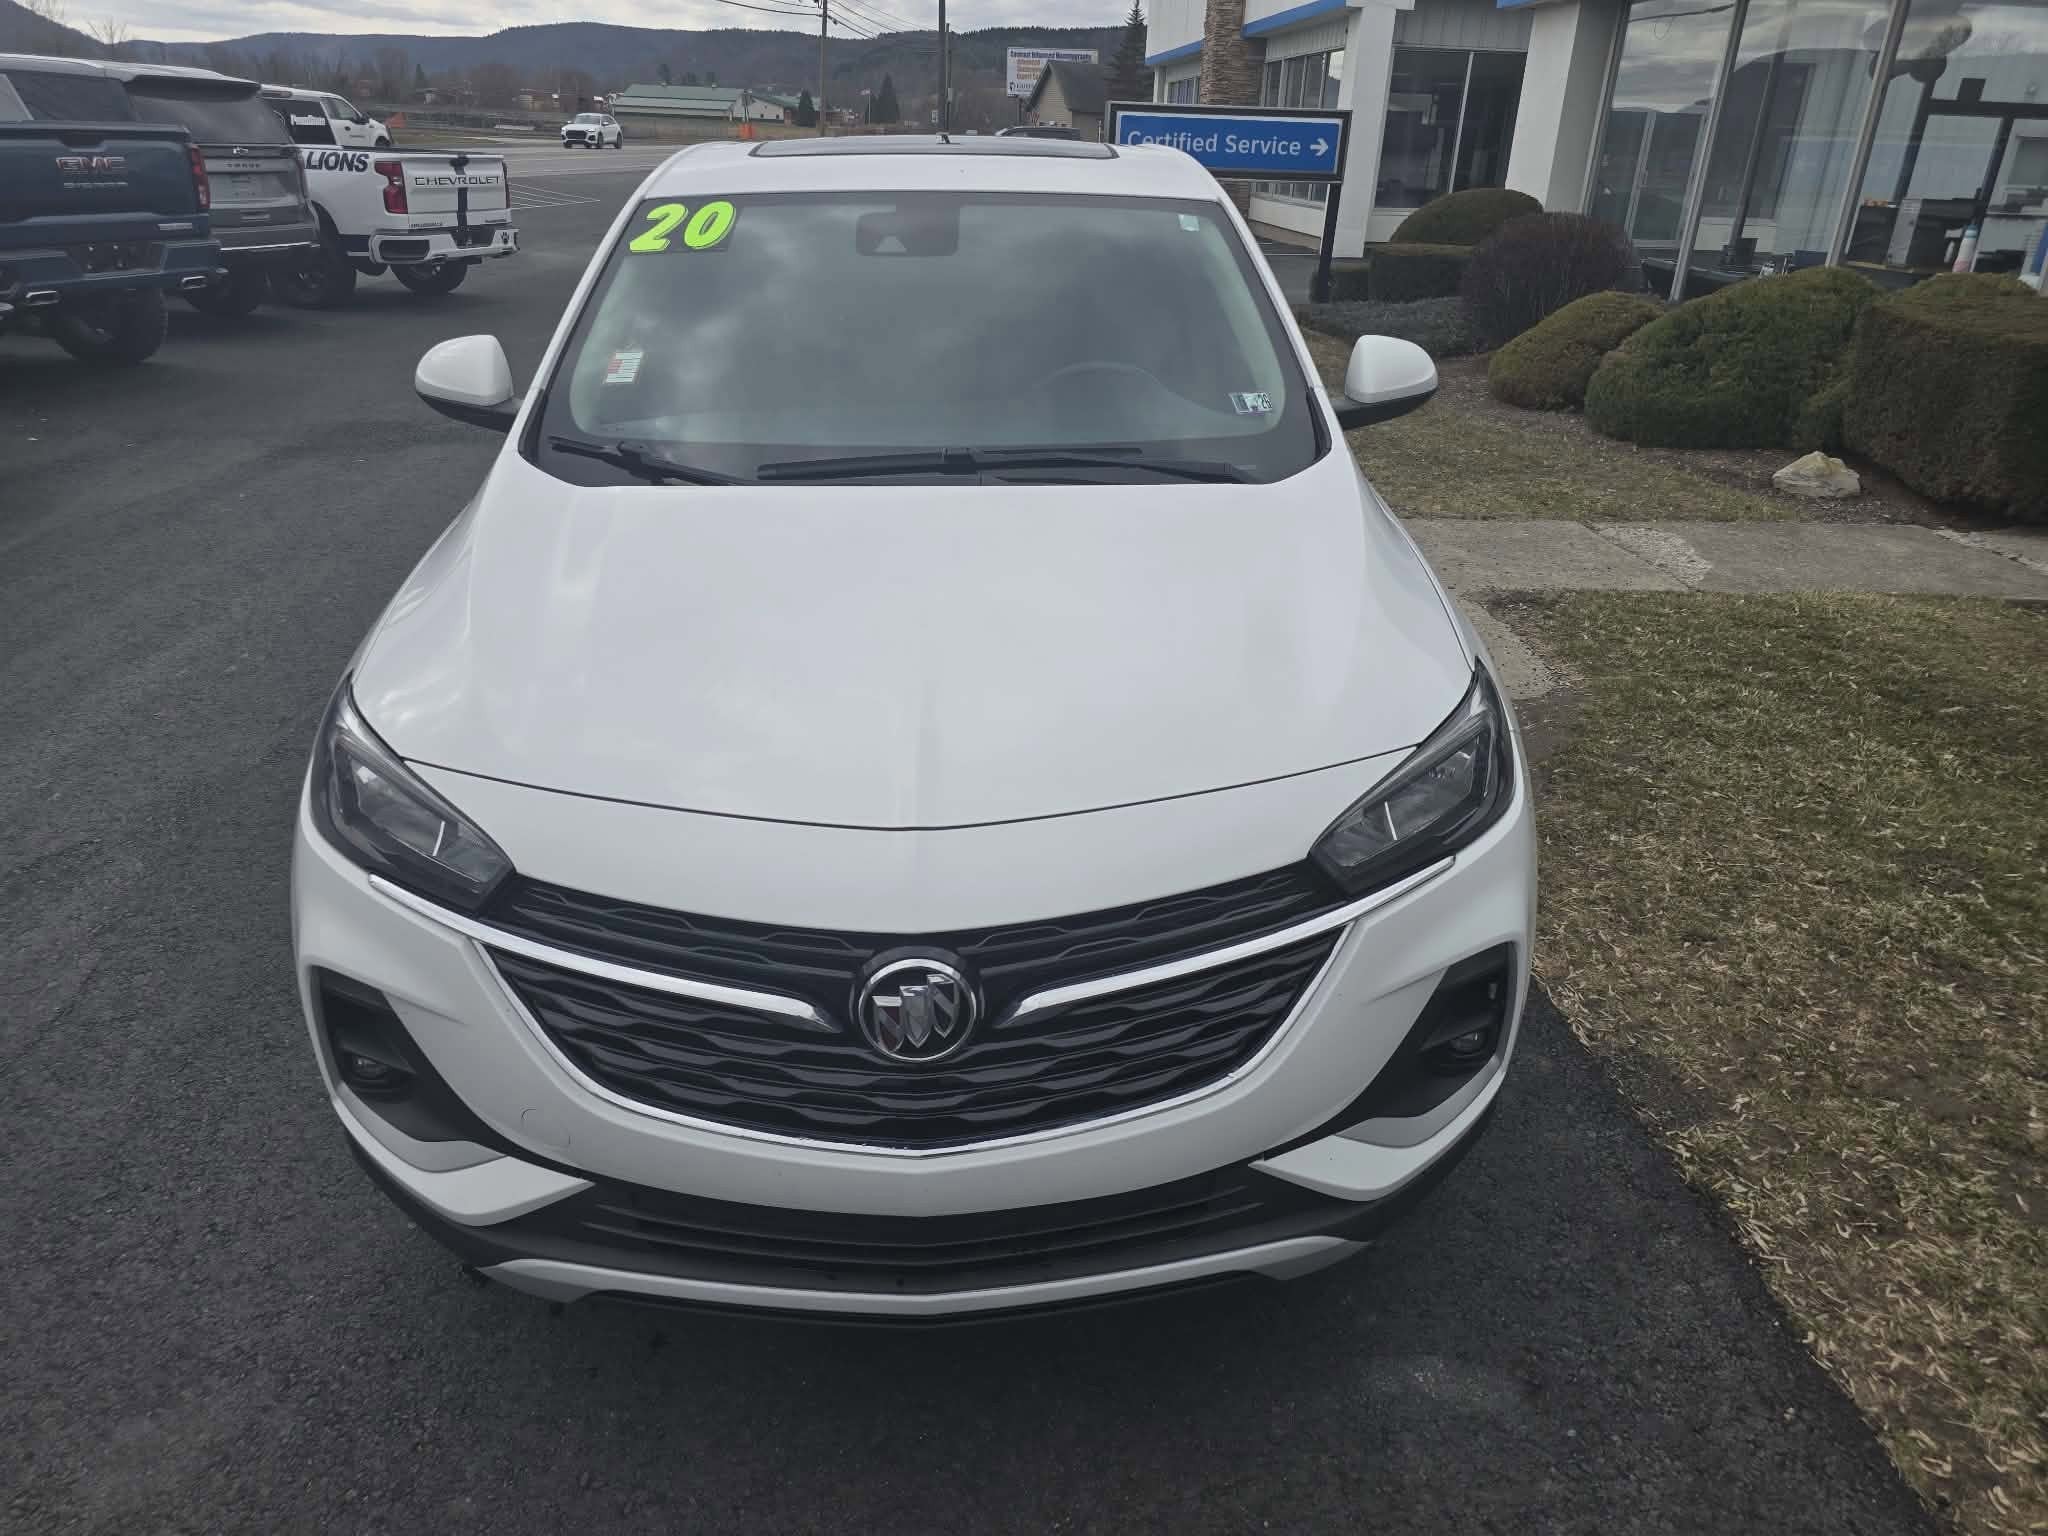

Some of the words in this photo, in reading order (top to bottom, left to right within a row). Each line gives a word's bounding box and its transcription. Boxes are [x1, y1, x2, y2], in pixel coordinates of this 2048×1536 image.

[1127, 130, 1218, 153] Certified
[1224, 134, 1301, 156] Service
[56, 156, 125, 176] GMC
[304, 151, 369, 172] LIONS
[415, 175, 499, 186] CHEVROLET
[629, 200, 737, 252] 20
